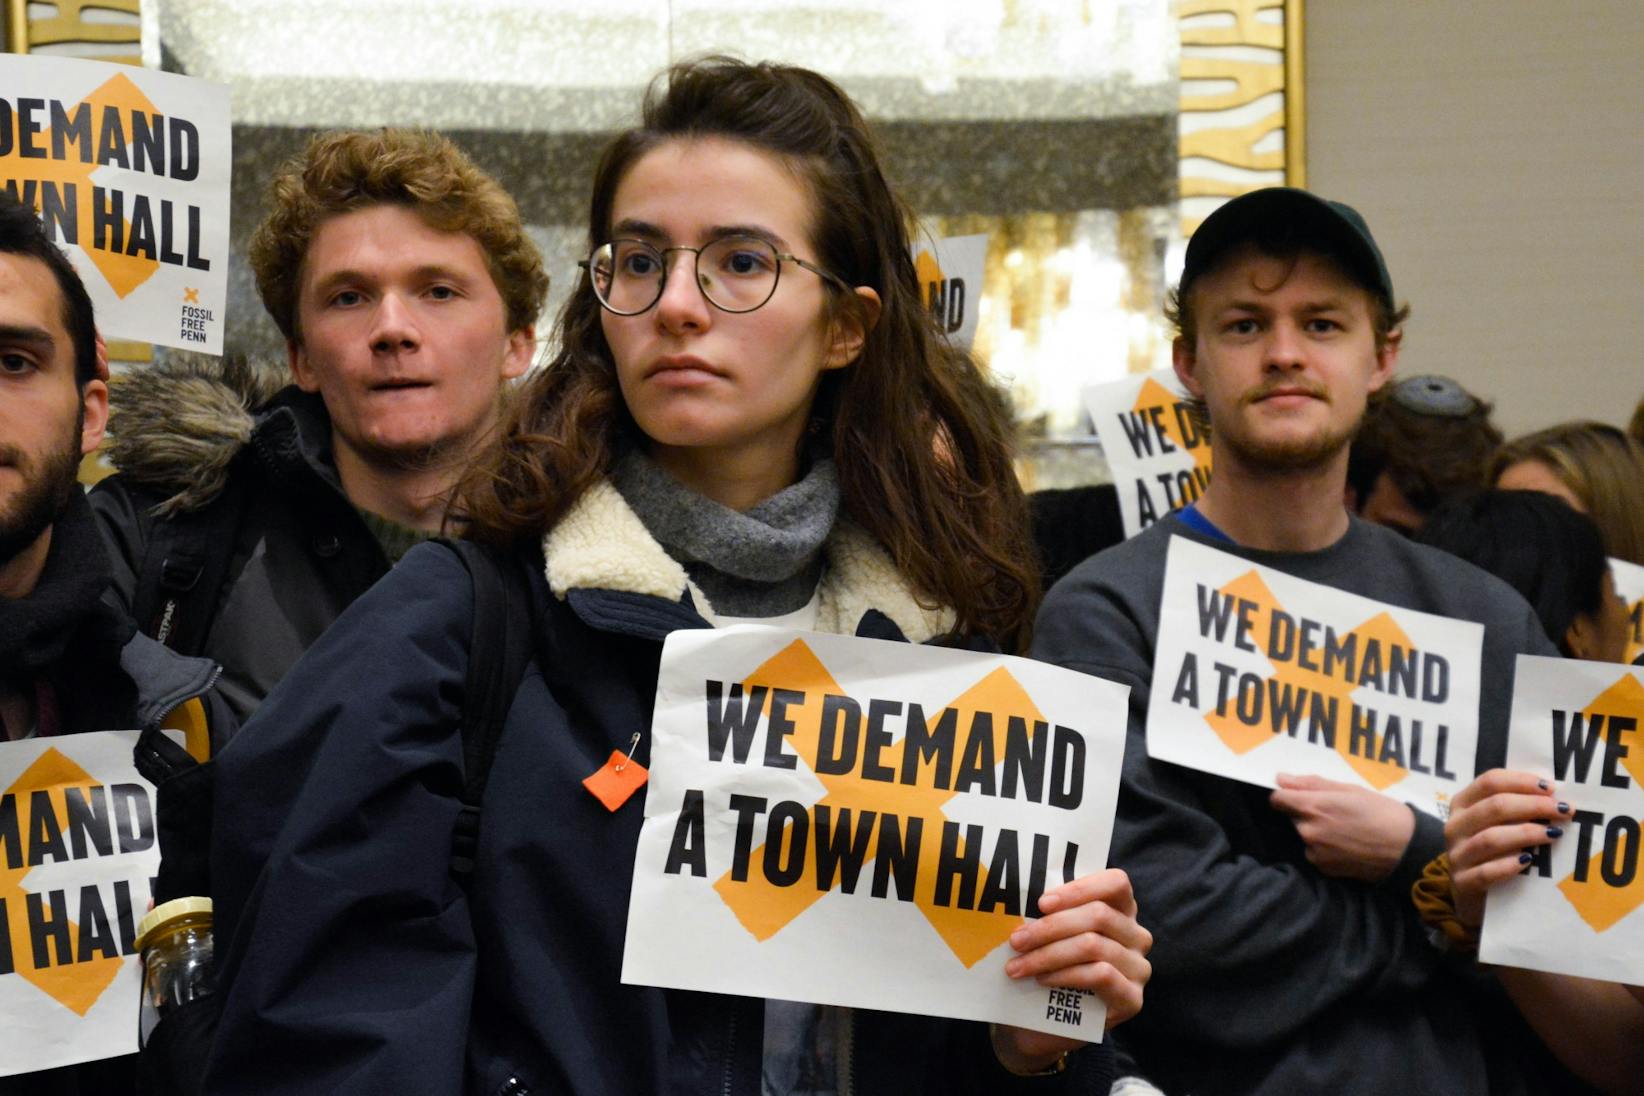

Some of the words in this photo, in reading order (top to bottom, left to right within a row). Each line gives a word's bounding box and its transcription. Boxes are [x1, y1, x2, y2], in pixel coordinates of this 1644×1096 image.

[93, 186, 210, 271] HALL
[180, 329, 207, 343] PENN
[181, 317, 205, 331] FREE
[182, 305, 215, 321] FOSSIL
[1118, 405, 1176, 459] WE
[1136, 478, 1158, 528] A
[1197, 583, 1259, 653] WE
[1268, 608, 1449, 704] DEMAND
[705, 680, 804, 770] WE
[815, 694, 1087, 811] DEMAND
[1171, 651, 1200, 710] A
[1214, 662, 1339, 750] TOWN
[1349, 703, 1457, 781] HALL
[1552, 709, 1637, 790] WE
[664, 789, 707, 878] A
[728, 793, 922, 902] TOWN
[1572, 810, 1641, 888] TO
[25, 877, 158, 969] HAL
[1046, 1005, 1082, 1026] PENN
[1048, 989, 1082, 1009] FREE
